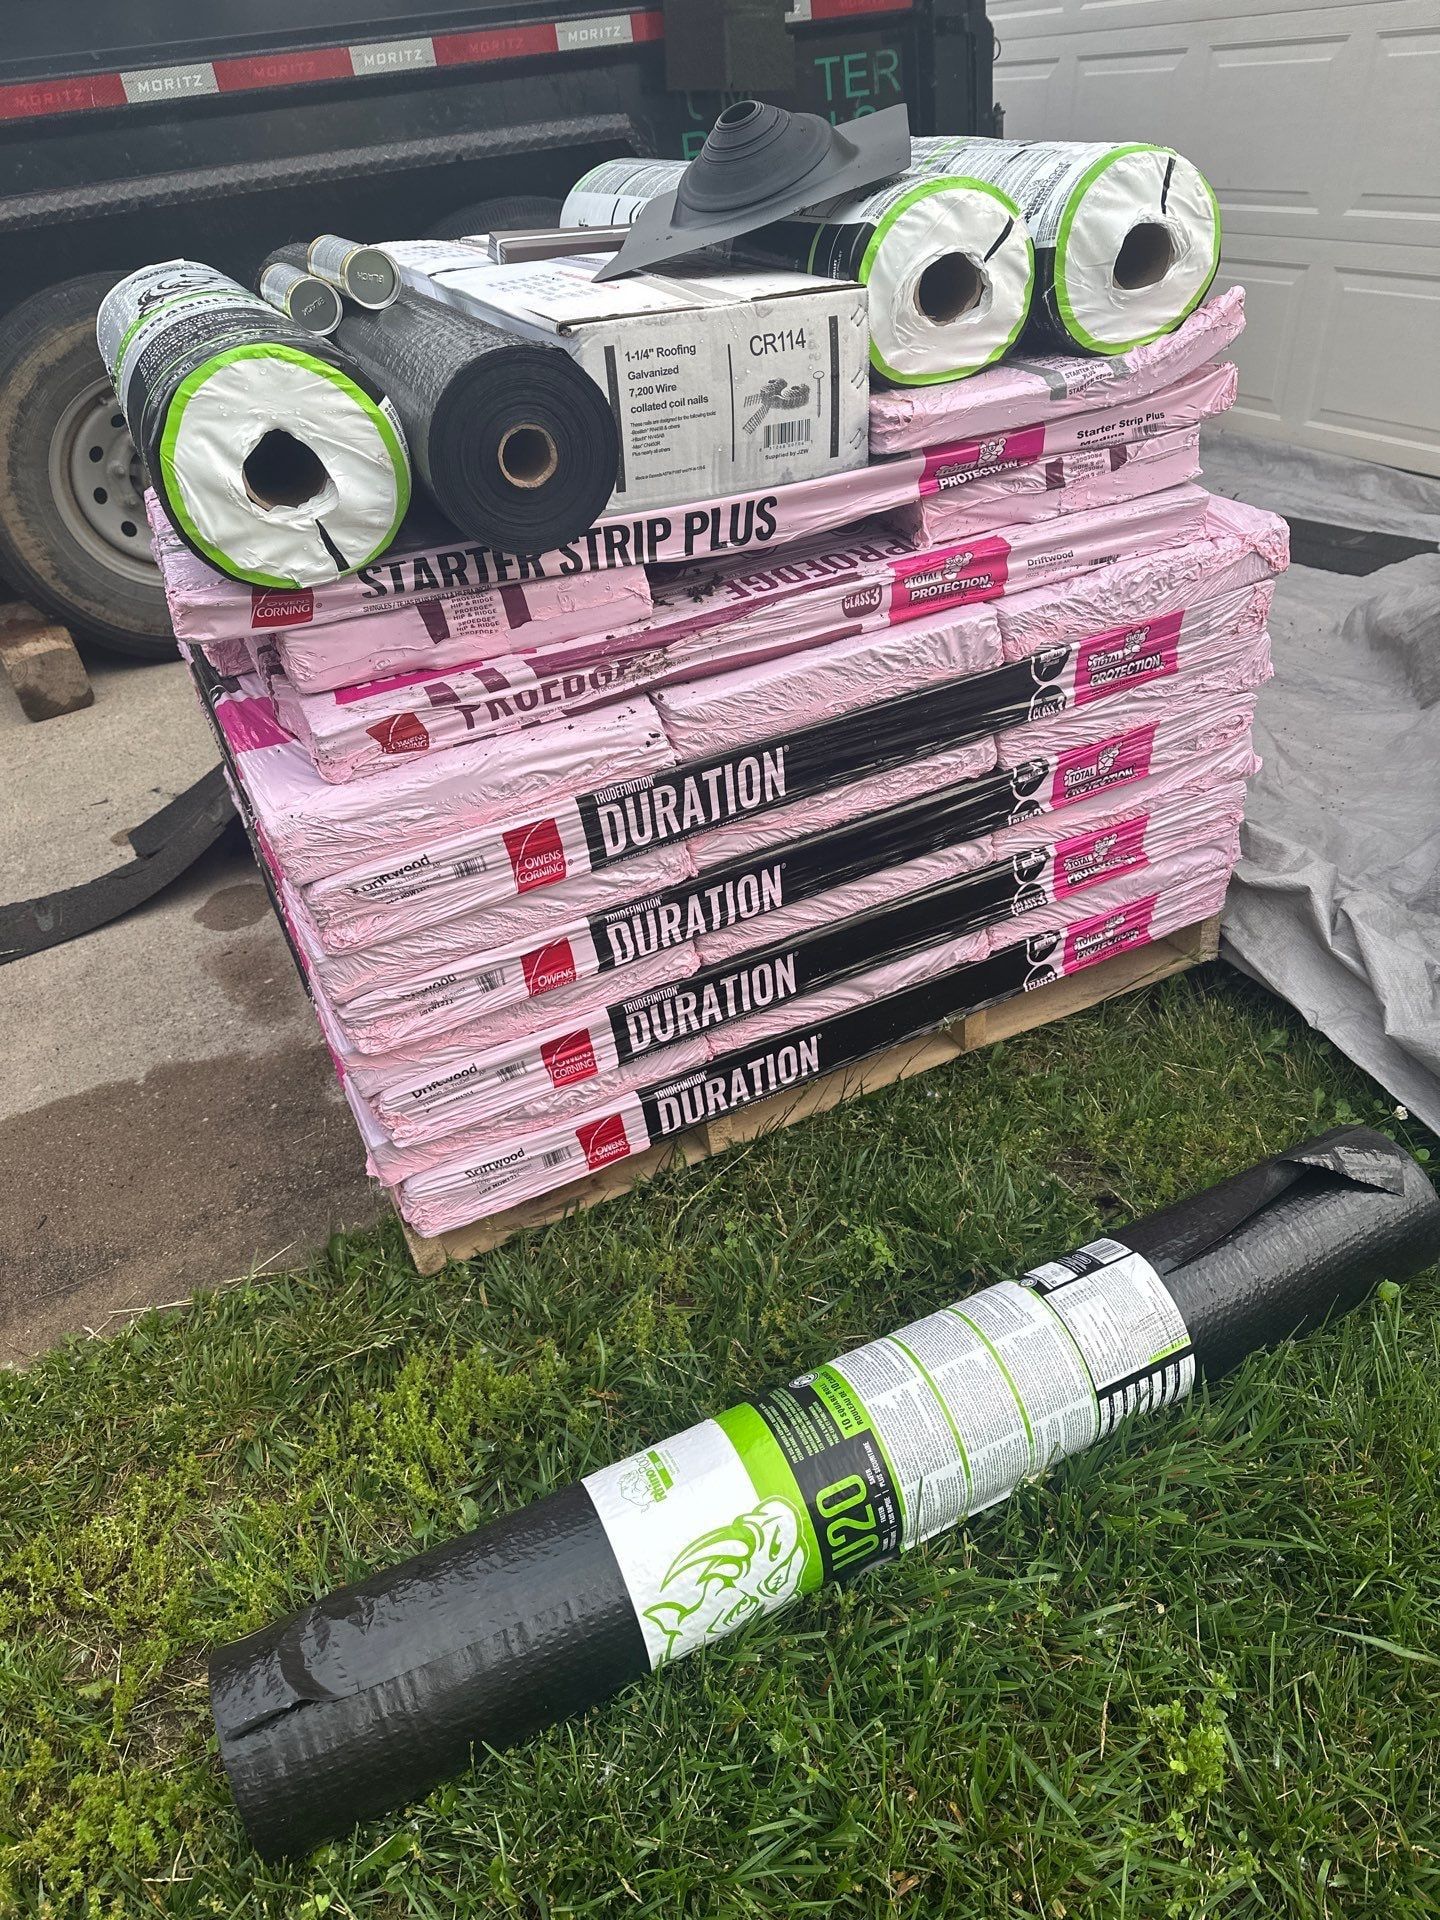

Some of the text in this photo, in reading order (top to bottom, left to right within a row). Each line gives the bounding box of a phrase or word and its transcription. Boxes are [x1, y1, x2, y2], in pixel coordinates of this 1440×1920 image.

[568, 25, 622, 44] MORITZ
[469, 36, 523, 53] MORITZ
[363, 48, 423, 67] MORITZ
[252, 61, 318, 78] MORITZ
[814, 48, 901, 101] TER
[137, 74, 204, 94] MORITZ
[356, 270, 384, 284] BLACK
[750, 328, 806, 357] CR114
[625, 344, 696, 362] 1-1/4" Roofing
[628, 365, 679, 380] Galvanized
[629, 384, 677, 398] 7,200 Wire
[630, 395, 709, 413] collated coil nails
[1077, 411, 1165, 439] Starter Strip Plus
[1080, 432, 1125, 446] Medina
[765, 451, 789, 460] Supplied
[938, 460, 1018, 490] PROTECTION
[360, 496, 778, 600] STARTER STRIP PLUS
[1027, 550, 1074, 566] Driftwood
[722, 538, 918, 601] PROEDGE
[911, 572, 939, 585] TOTAL
[910, 573, 989, 600] PROTECTION
[472, 596, 494, 605] RIDGE
[844, 586, 880, 610] CLASS 3
[256, 603, 311, 618] CORNING
[453, 613, 466, 621] HIP
[474, 608, 498, 617] RIDGE
[456, 624, 469, 632] HIP
[477, 621, 500, 629] RIDGE
[1090, 653, 1162, 687] PROTECTION
[1070, 767, 1095, 783] TOTAL
[593, 774, 655, 805] TRUDEFINITION
[524, 850, 562, 869] OWENS
[1069, 857, 1091, 869] TOTAL
[518, 863, 564, 884] CORNING
[604, 896, 662, 923] TRUDEFINITION
[538, 969, 575, 987] OWENS
[622, 985, 679, 1014] TRUDEFINITION
[554, 1058, 595, 1079] CORNING
[412, 1062, 478, 1098] Driftwood
[654, 1070, 708, 1100] TRUDEFINITION
[595, 1139, 627, 1156] OWENS
[465, 1147, 525, 1178] Driftwood
[830, 1382, 841, 1392] 10
[820, 1383, 853, 1430] 10 SQUARE ROLL
[844, 1397, 864, 1426] ROULEAU
[865, 1467, 876, 1485] SAFER
[876, 1473, 886, 1488] PLUS
[816, 1474, 880, 1571] U20
